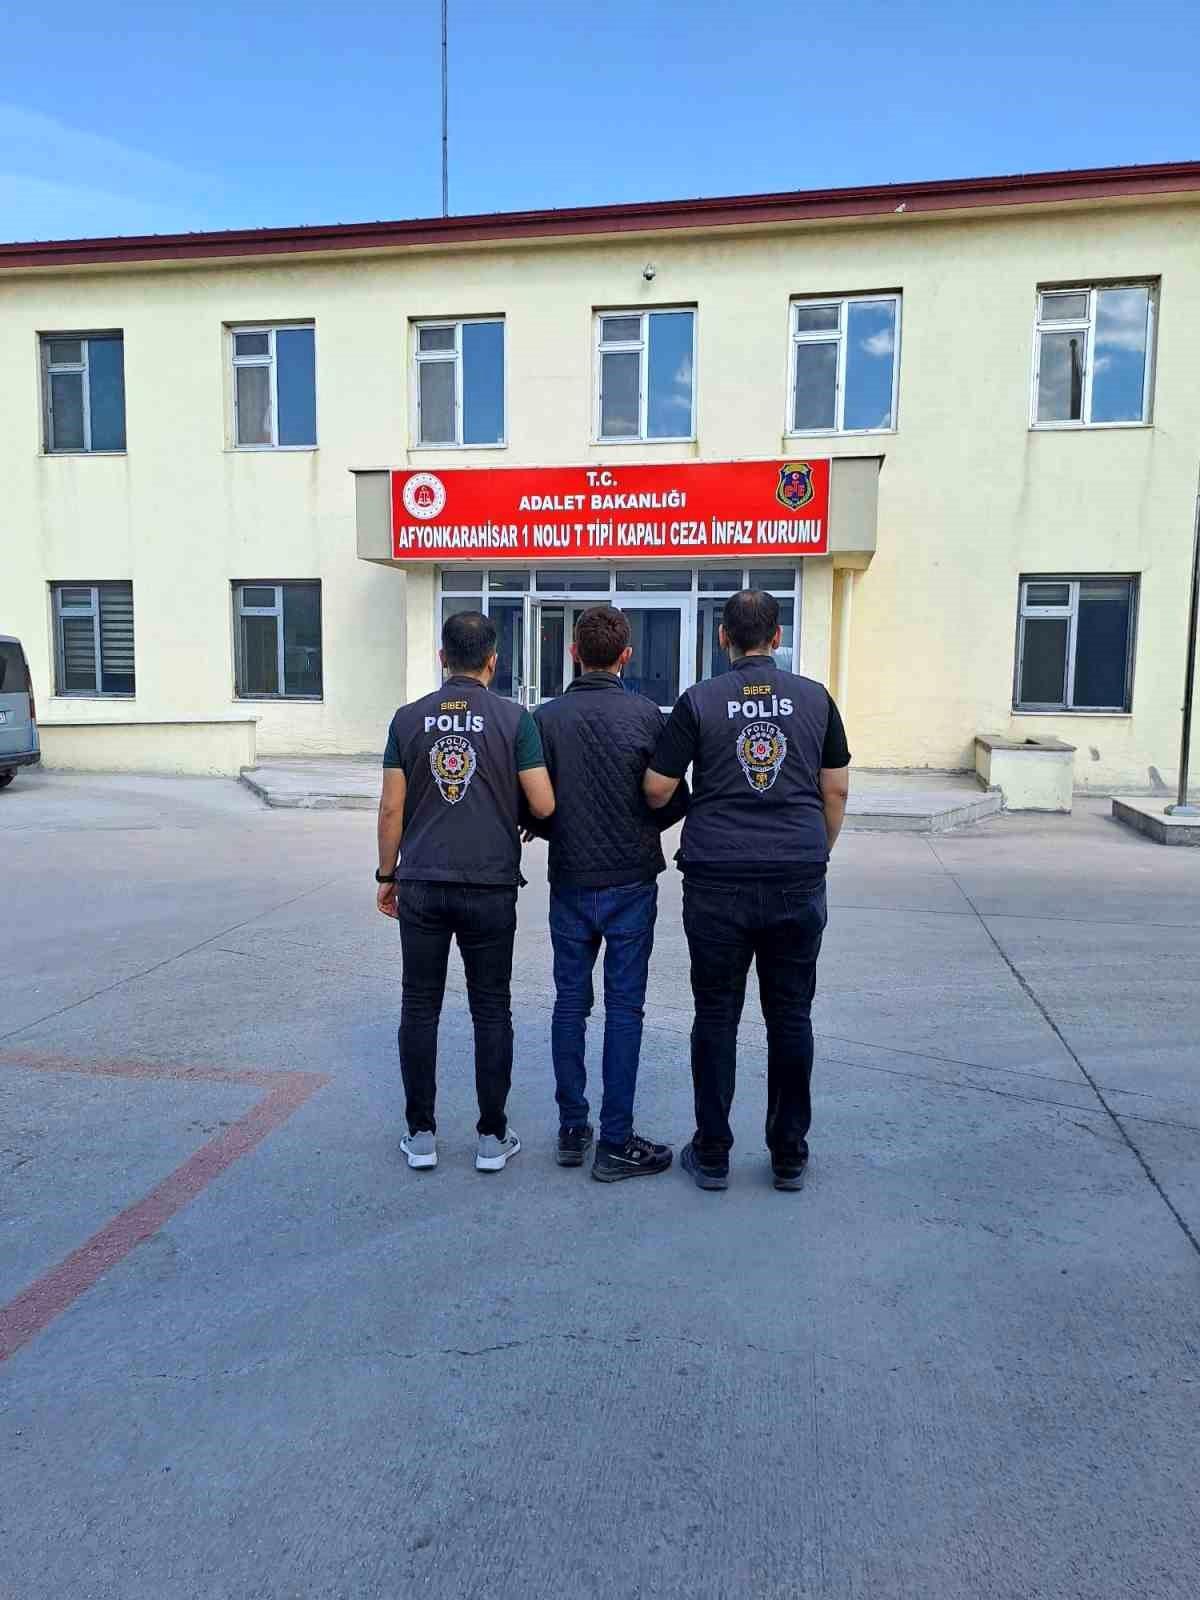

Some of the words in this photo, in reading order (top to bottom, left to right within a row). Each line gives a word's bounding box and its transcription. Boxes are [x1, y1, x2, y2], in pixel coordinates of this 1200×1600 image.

[586, 471, 618, 487] T.C.
[519, 495, 585, 511] ADALET
[591, 490, 687, 510] BAKANLIĞI
[400, 520, 518, 549] AFYONKARAHİSAR
[522, 524, 529, 547] 1
[533, 523, 570, 547] NOLU
[574, 523, 583, 546] T
[587, 518, 613, 546] TİPİ
[617, 521, 666, 546] KAPALI
[670, 521, 707, 545] CEZA
[712, 516, 752, 545] İNFAZ
[757, 519, 821, 544] KURUMU
[727, 694, 794, 719] POLİS
[424, 711, 485, 733] POLİS
